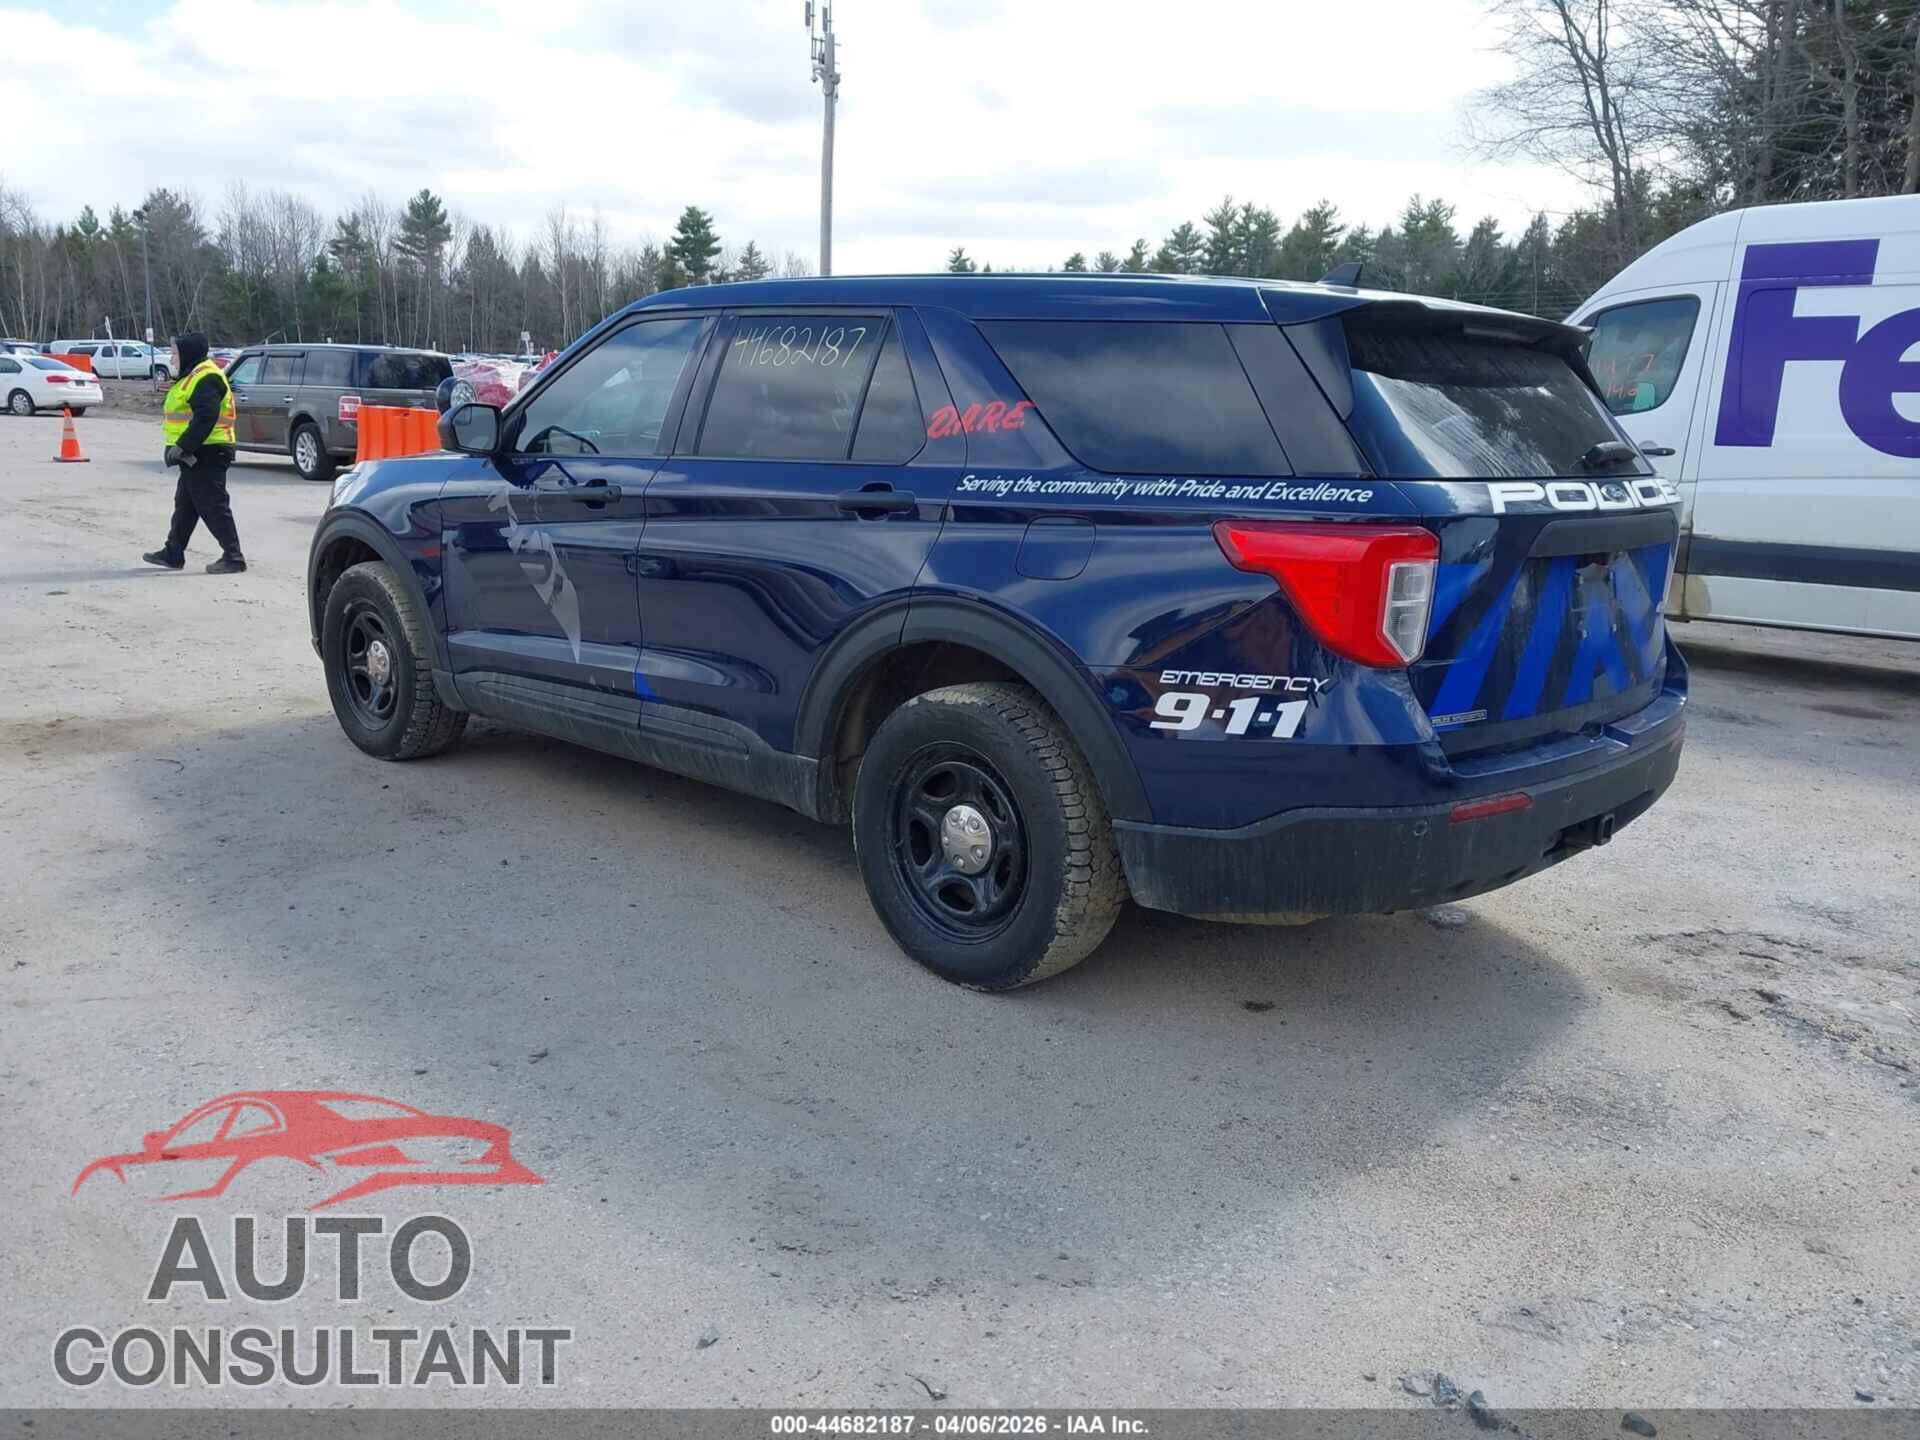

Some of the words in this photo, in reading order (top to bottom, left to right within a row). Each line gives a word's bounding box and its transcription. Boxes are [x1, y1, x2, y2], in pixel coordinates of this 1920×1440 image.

[735, 326, 866, 368] 44682187
[956, 474, 1013, 497] Serving
[1013, 475, 1041, 493] the
[1040, 477, 1132, 500] community
[1134, 478, 1176, 497] with
[1176, 479, 1226, 498] Pride
[1225, 481, 1267, 500] and
[1264, 482, 1374, 502] Excellence
[1487, 478, 1683, 514] POLICE
[1159, 669, 1330, 693] EMERGENCY
